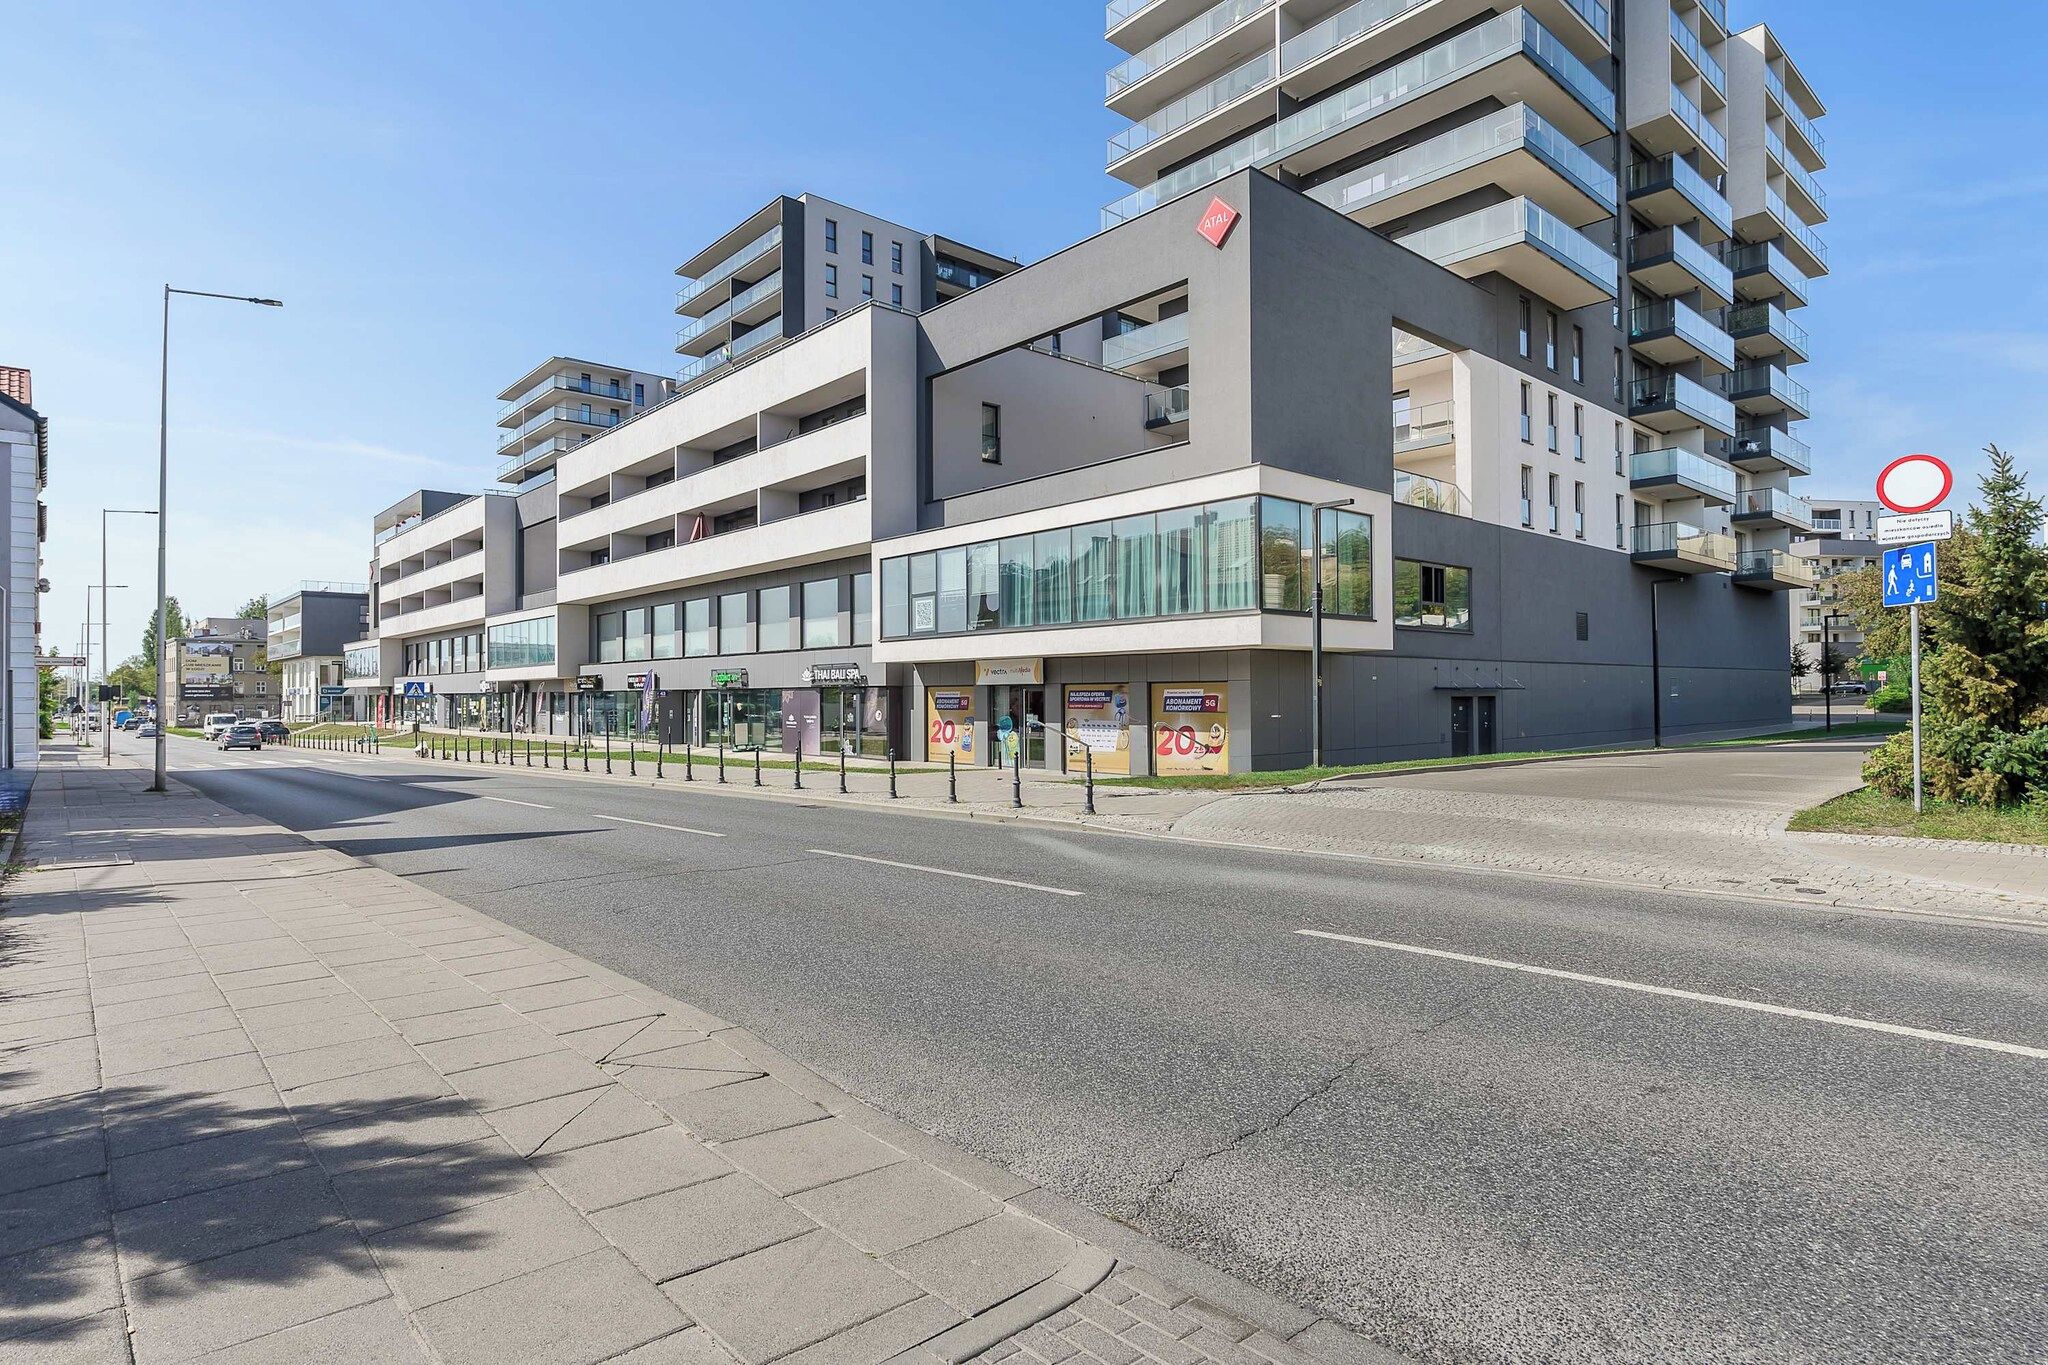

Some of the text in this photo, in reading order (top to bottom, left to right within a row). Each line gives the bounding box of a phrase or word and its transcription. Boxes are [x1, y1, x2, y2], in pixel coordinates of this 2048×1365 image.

[1203, 211, 1229, 231] ATAL
[813, 669, 860, 680] THAI BALI SPA
[1205, 699, 1216, 707] 5G
[930, 719, 956, 744] 20
[1157, 725, 1196, 756] 20
